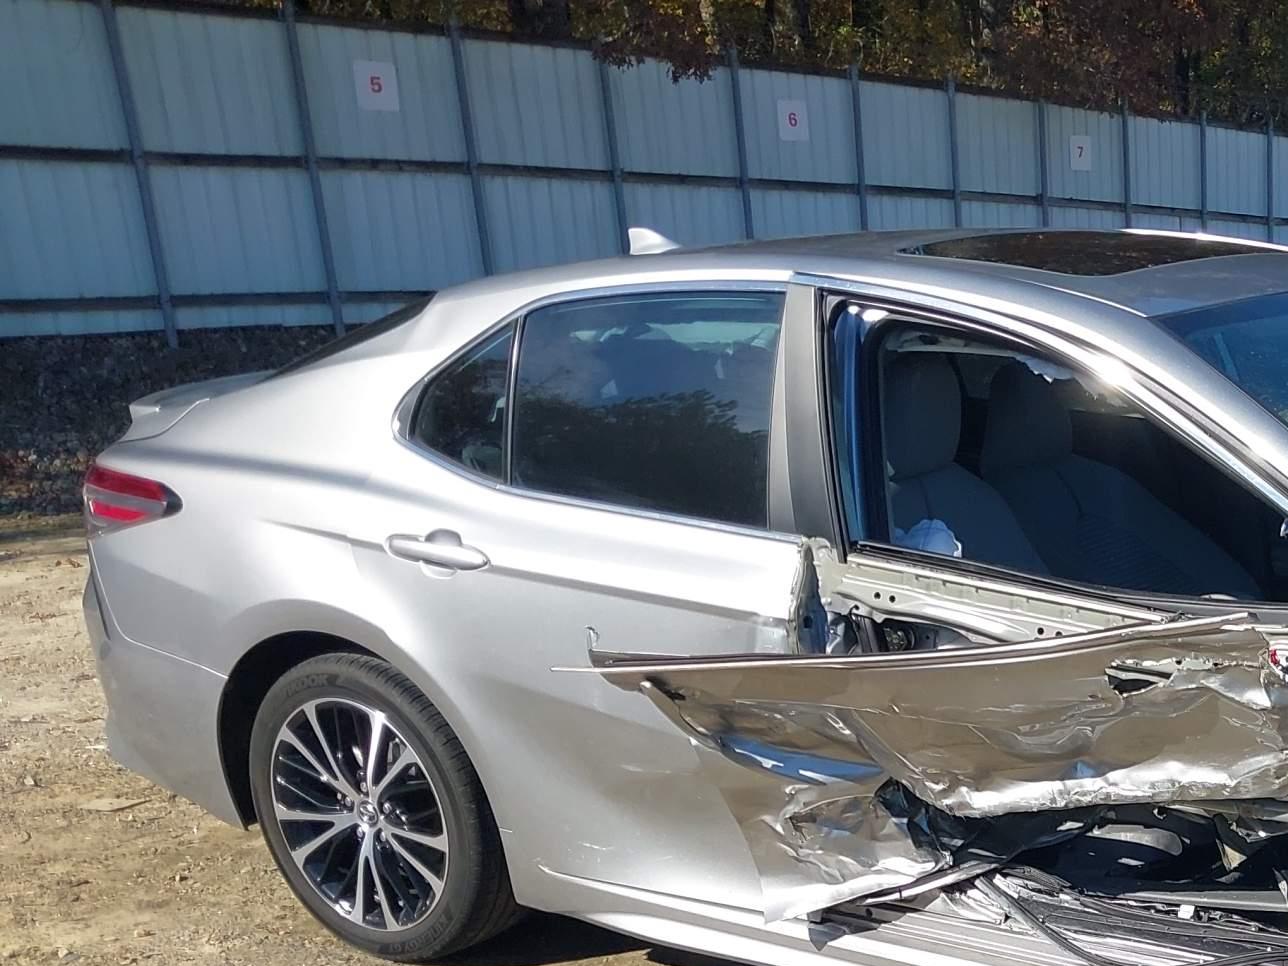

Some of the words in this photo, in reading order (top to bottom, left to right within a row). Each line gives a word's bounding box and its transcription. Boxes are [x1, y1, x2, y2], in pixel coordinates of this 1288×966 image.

[370, 76, 382, 94] 5
[788, 112, 798, 128] 6
[1076, 145, 1084, 159] 7
